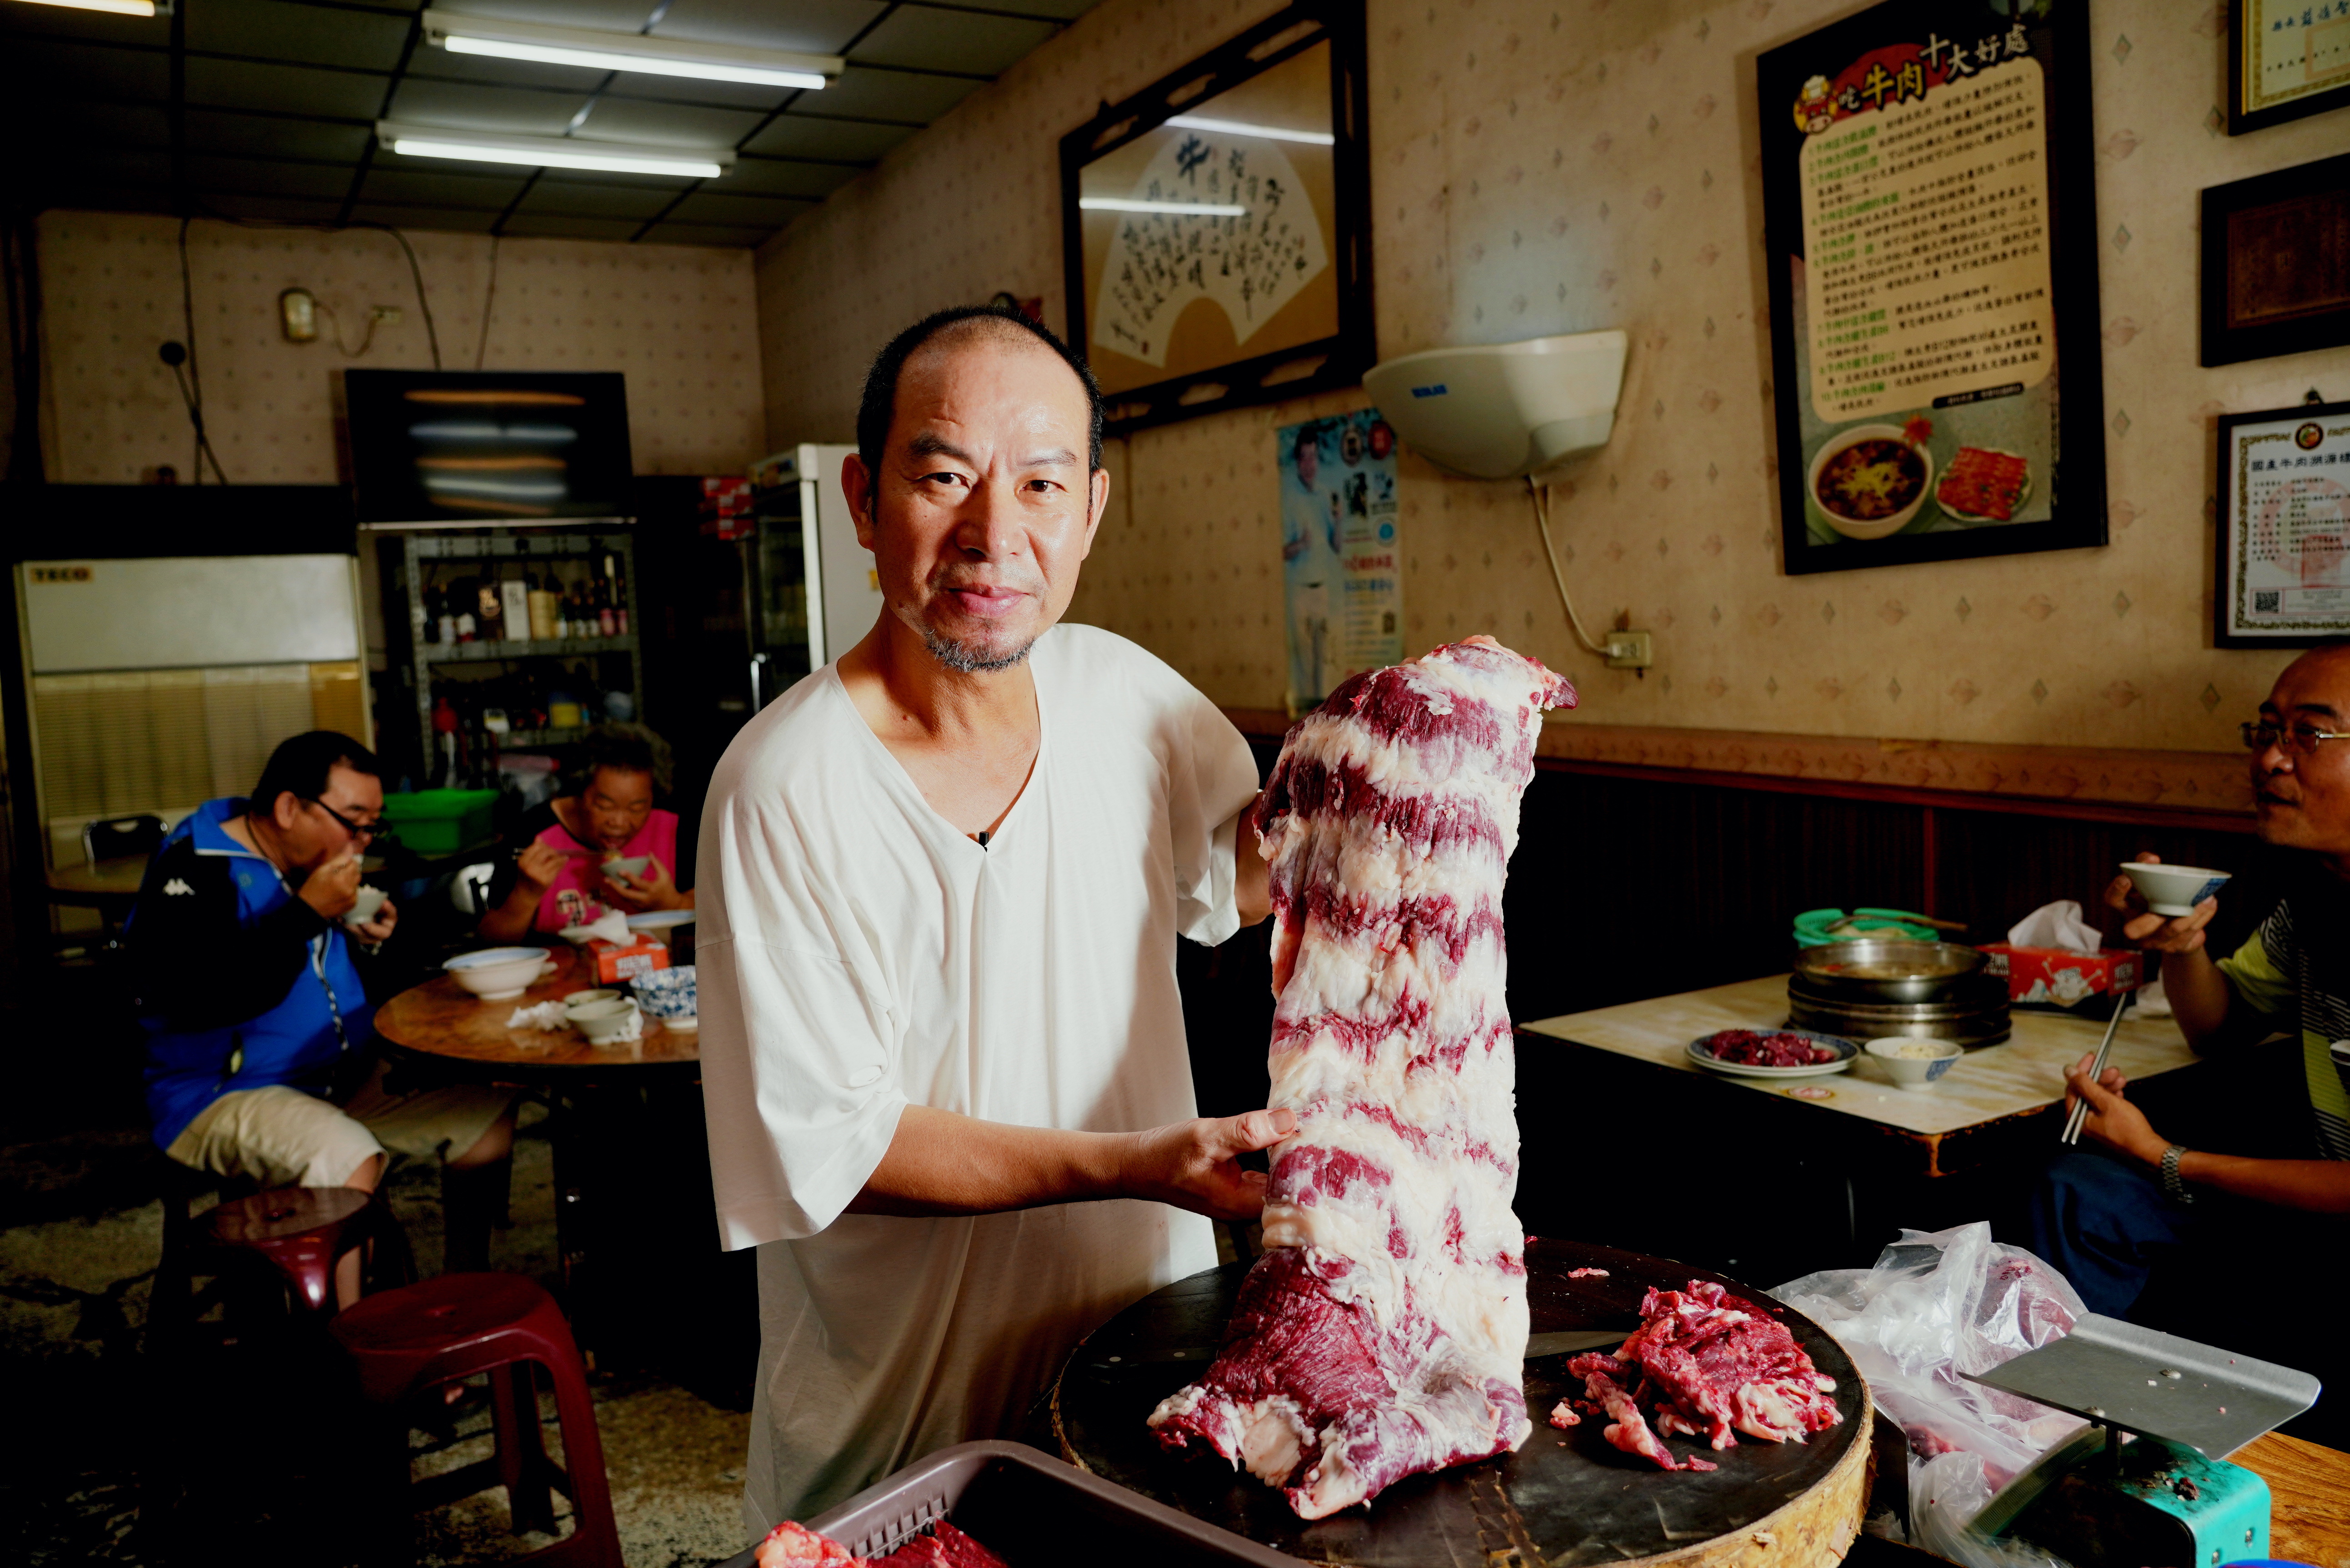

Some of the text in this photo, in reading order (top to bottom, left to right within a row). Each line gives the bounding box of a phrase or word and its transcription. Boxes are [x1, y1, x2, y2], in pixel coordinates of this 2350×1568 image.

[1838, 23, 2030, 111] 吃牛肉十大好處
